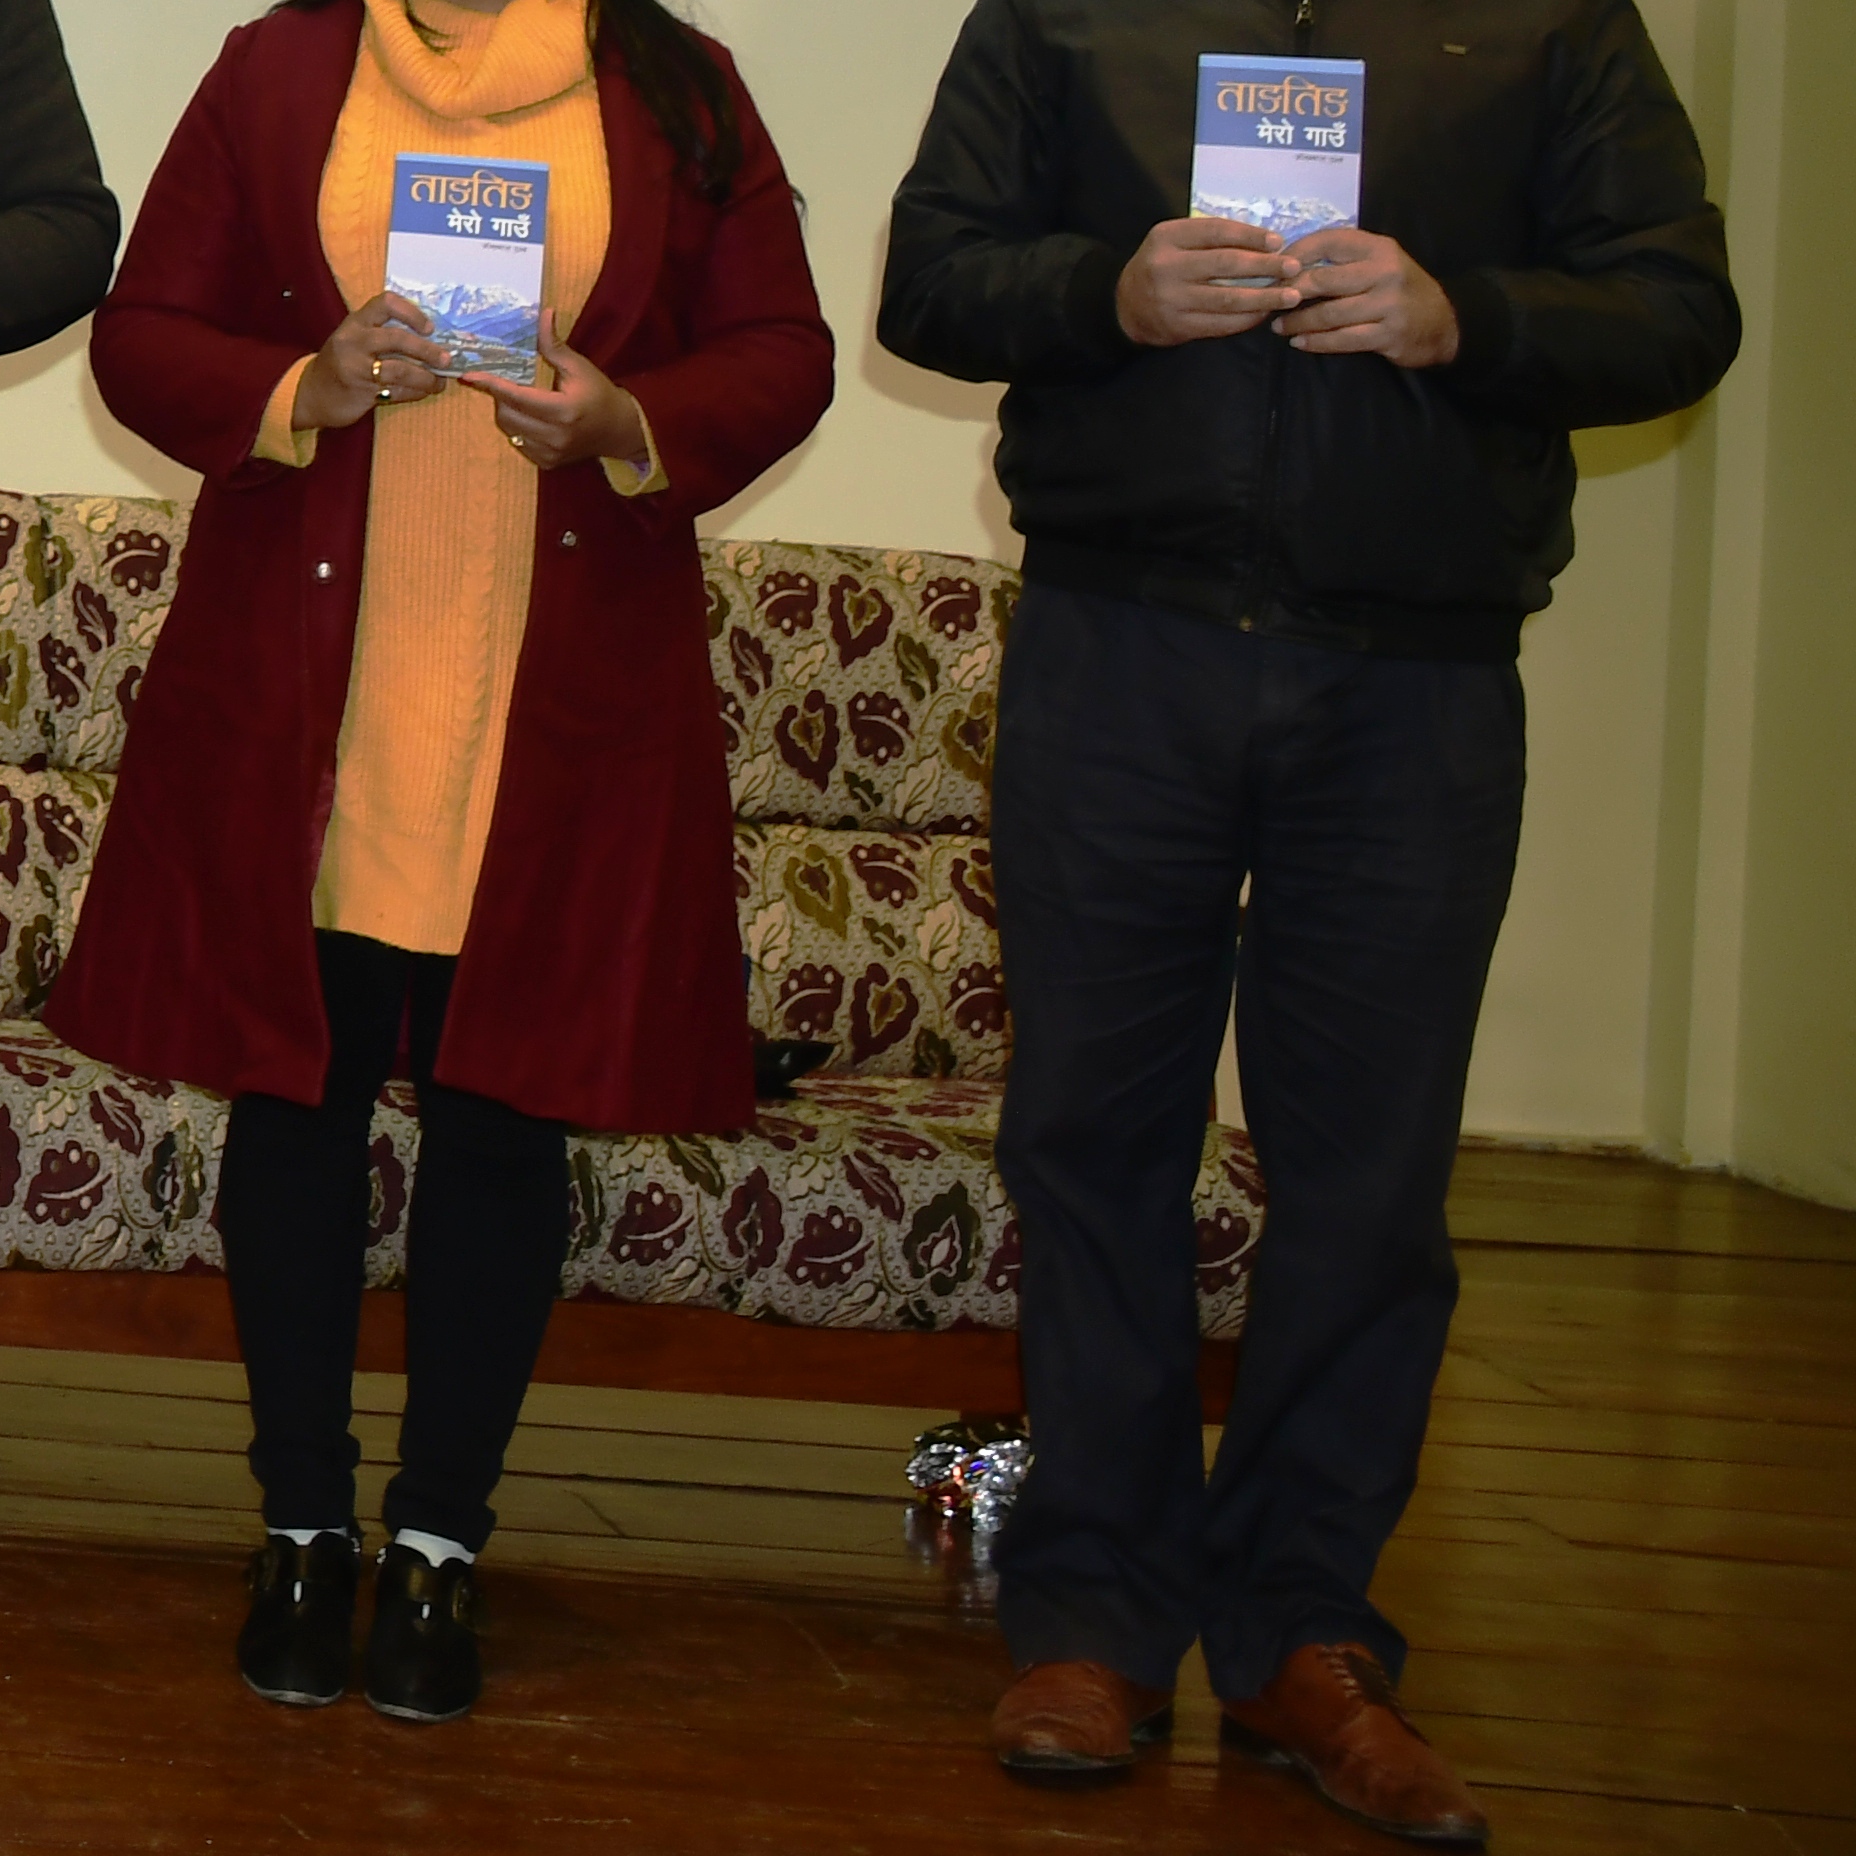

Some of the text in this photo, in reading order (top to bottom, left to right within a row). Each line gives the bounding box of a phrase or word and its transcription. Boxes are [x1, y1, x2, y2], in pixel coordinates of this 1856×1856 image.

[1216, 75, 1349, 119] ताङतिङ
[1255, 117, 1347, 148] मेरो गाउँ
[410, 168, 533, 211] ताङतिङ
[446, 207, 532, 239] मेरो गाउँ
